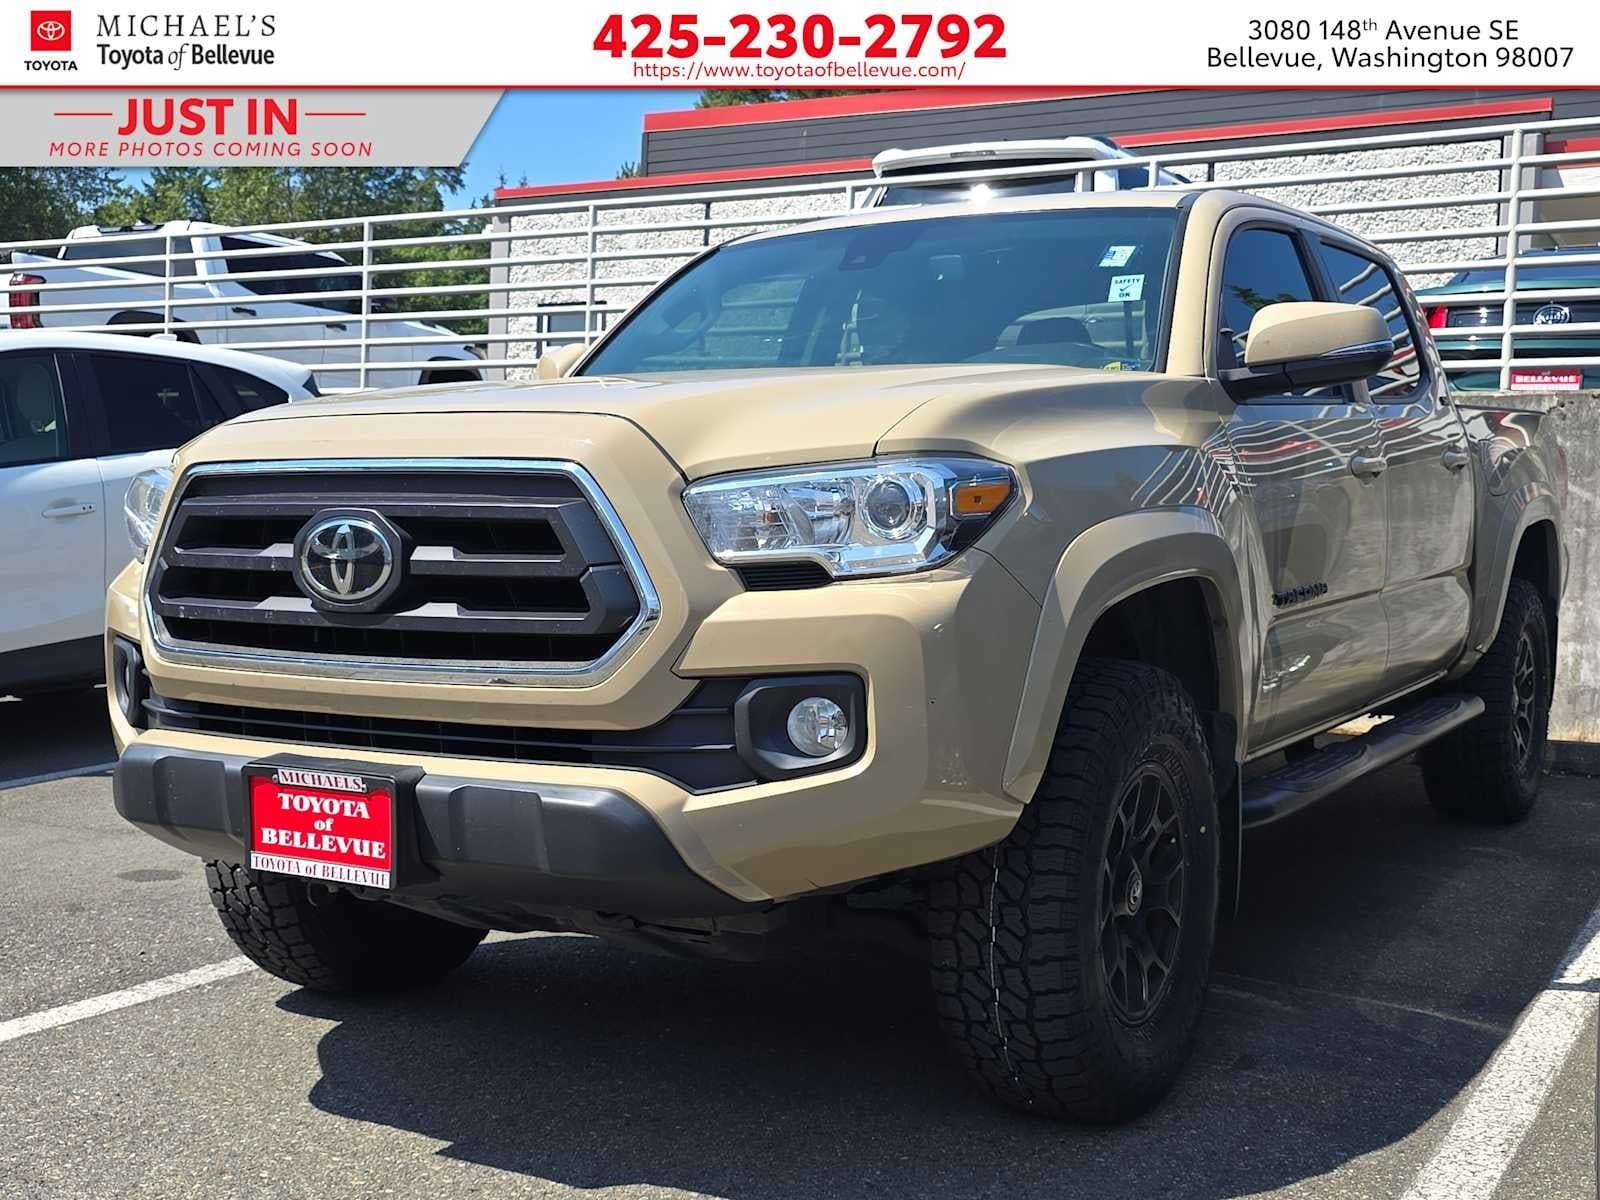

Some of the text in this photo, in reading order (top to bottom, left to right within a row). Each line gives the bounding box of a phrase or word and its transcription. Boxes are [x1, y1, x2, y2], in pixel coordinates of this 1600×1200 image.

[1515, 375, 1577, 383] BELLEVUE
[279, 770, 363, 791] MICHAELS
[277, 793, 370, 819] TOYOTA
[314, 818, 334, 831] of
[261, 828, 386, 859] BELLEVUE
[254, 855, 388, 886] TOYOTA of BELLEVUE
